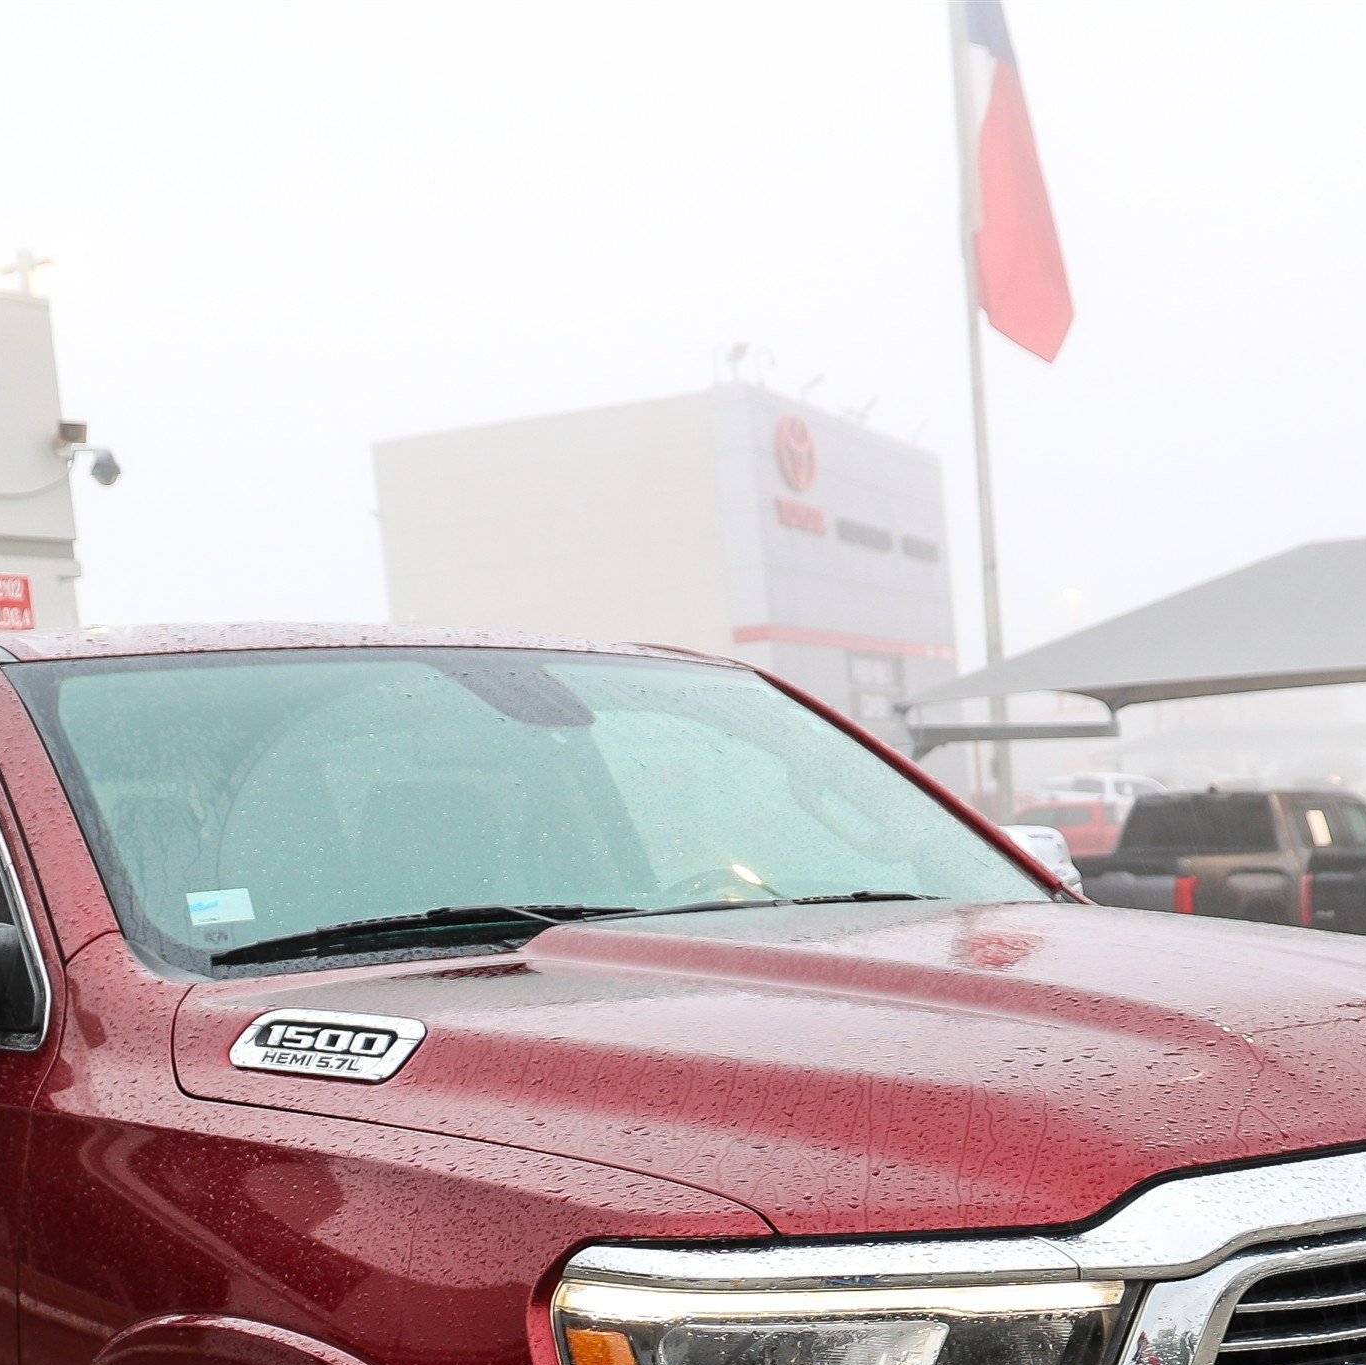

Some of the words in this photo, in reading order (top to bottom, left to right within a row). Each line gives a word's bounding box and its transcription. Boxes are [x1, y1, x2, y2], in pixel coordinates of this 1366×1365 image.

[266, 1023, 392, 1056] 1500
[261, 1050, 313, 1067] HEMI
[316, 1056, 360, 1073] 5.7L
